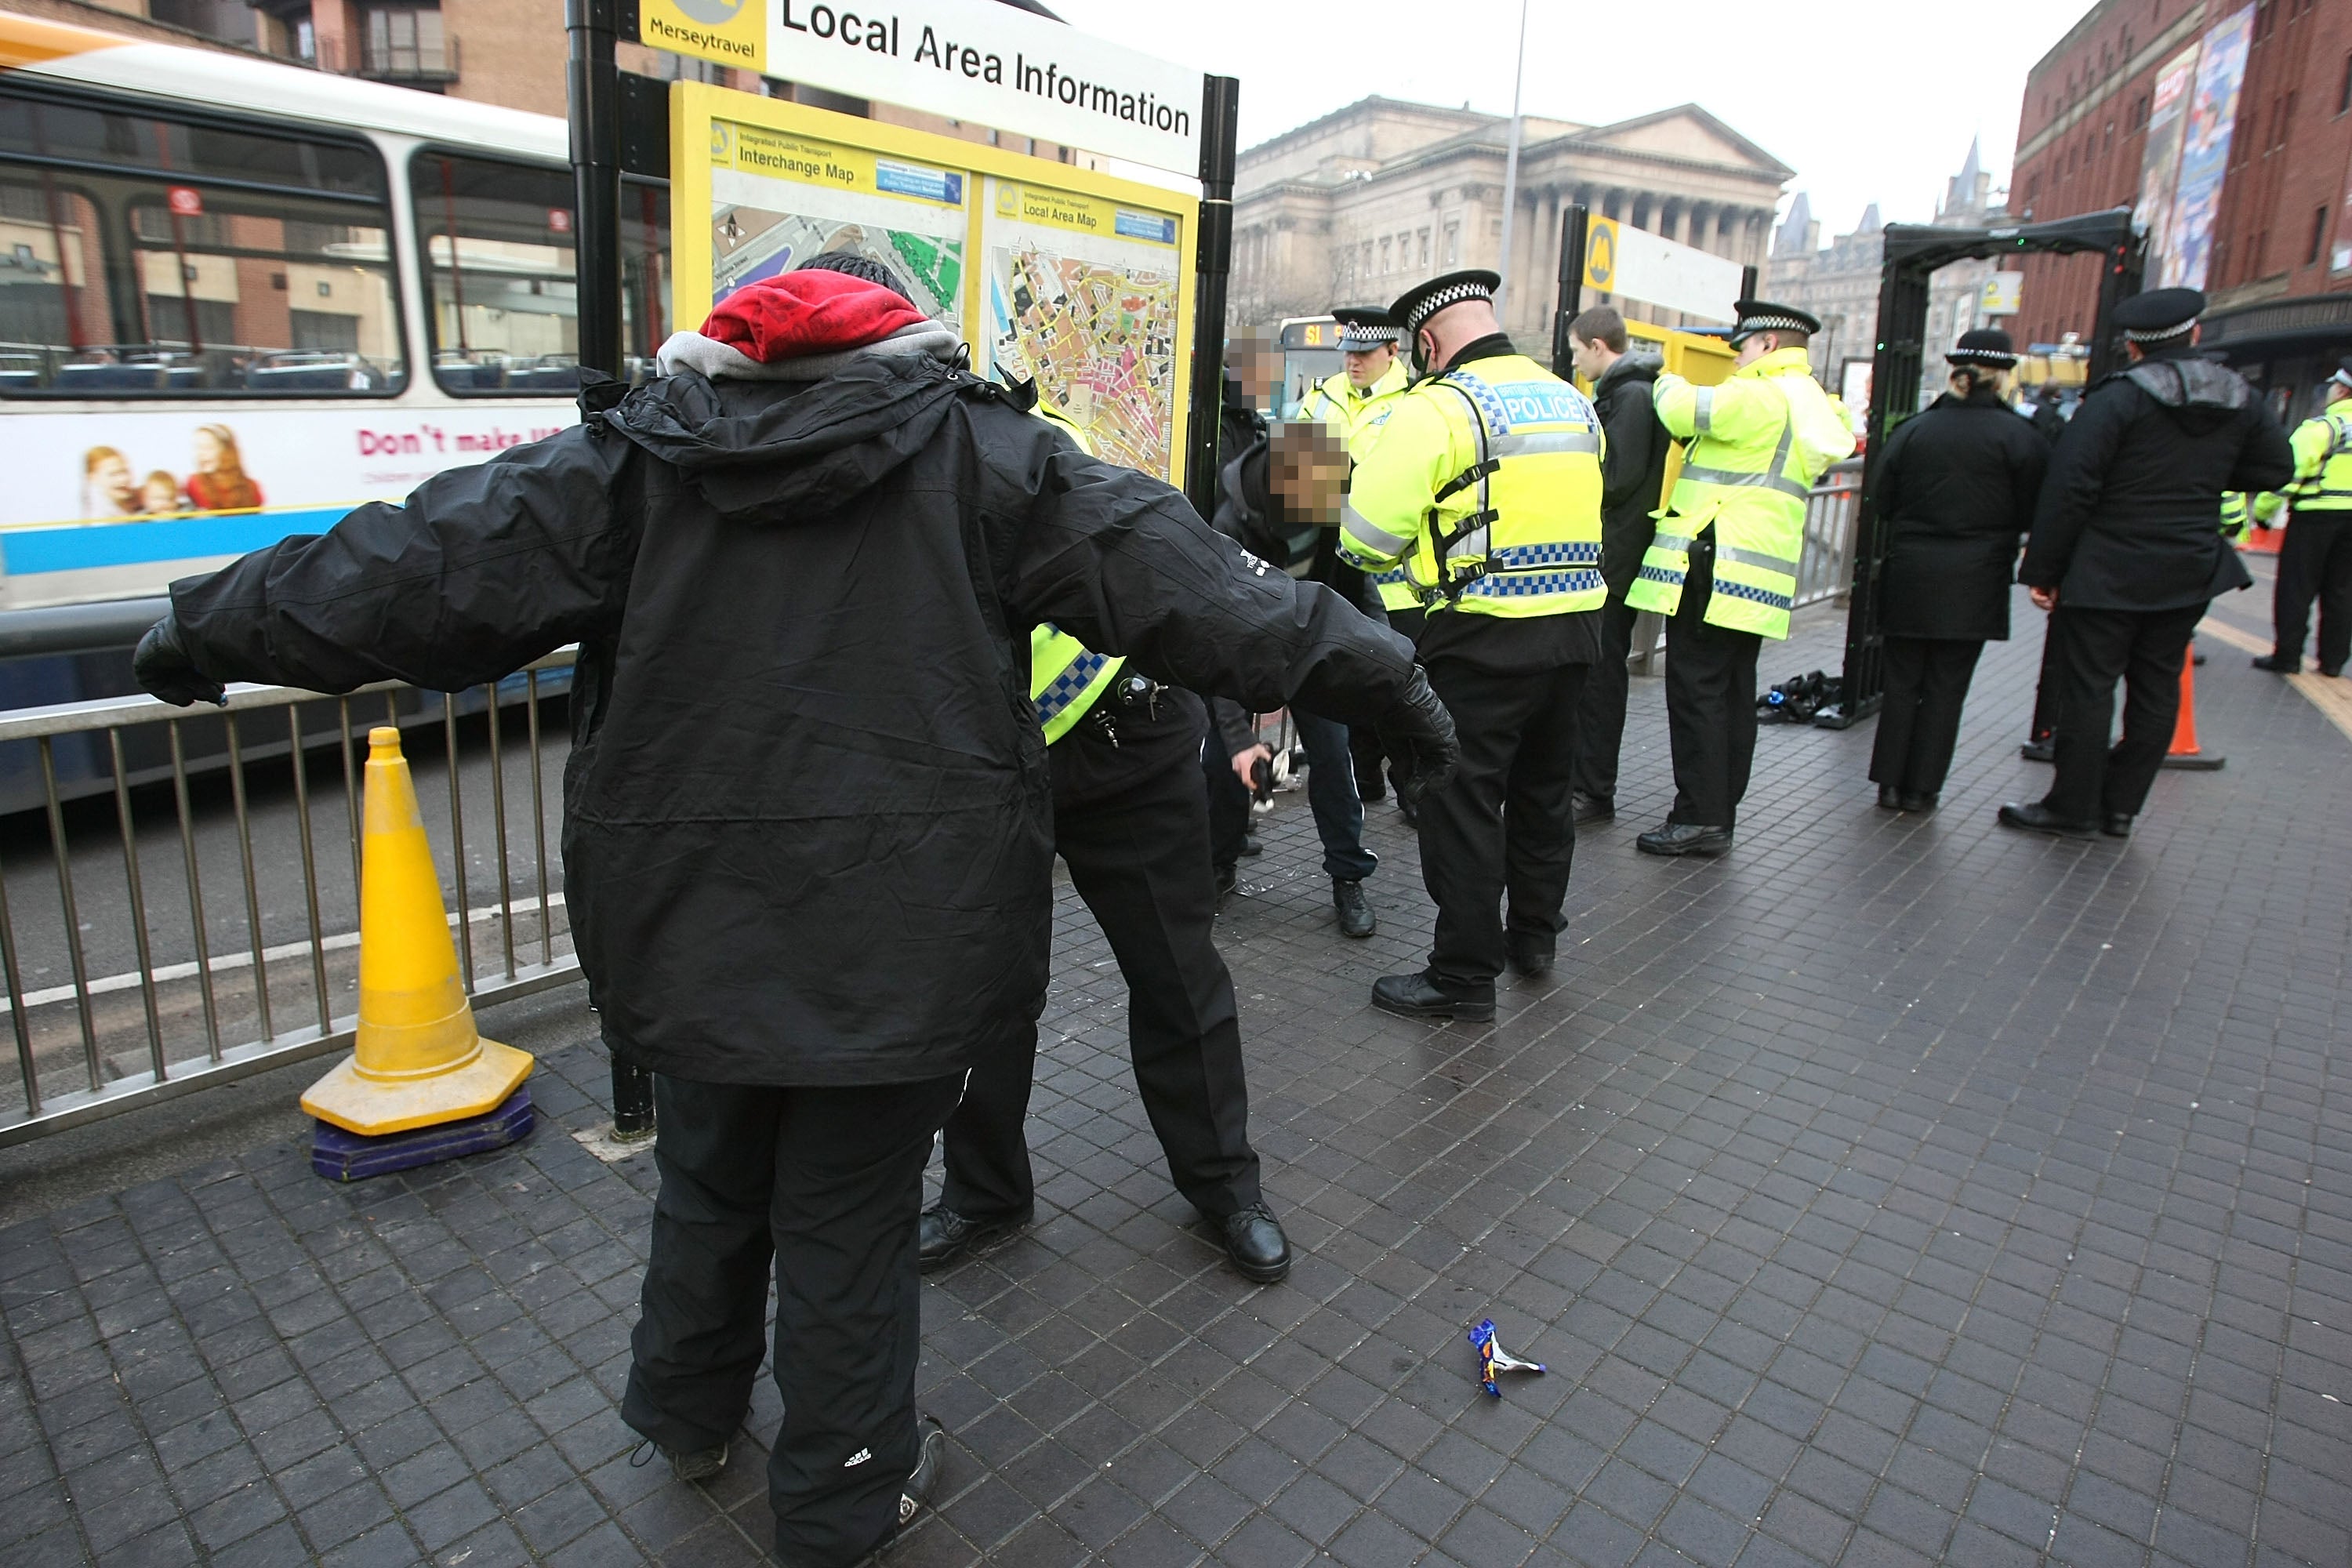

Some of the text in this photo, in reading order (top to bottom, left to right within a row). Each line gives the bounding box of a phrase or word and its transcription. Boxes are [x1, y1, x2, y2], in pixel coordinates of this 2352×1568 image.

[650, 17, 755, 59] Merseytravel
[782, 0, 1189, 137] Local Area Information
[739, 147, 821, 177] Interchange
[826, 163, 855, 184] Map
[728, 224, 736, 237] N
[1024, 201, 1049, 217] Local
[1051, 208, 1074, 223] Area
[1076, 212, 1097, 229] Map
[1506, 395, 1582, 421] POLICE
[357, 424, 445, 456] Don't
